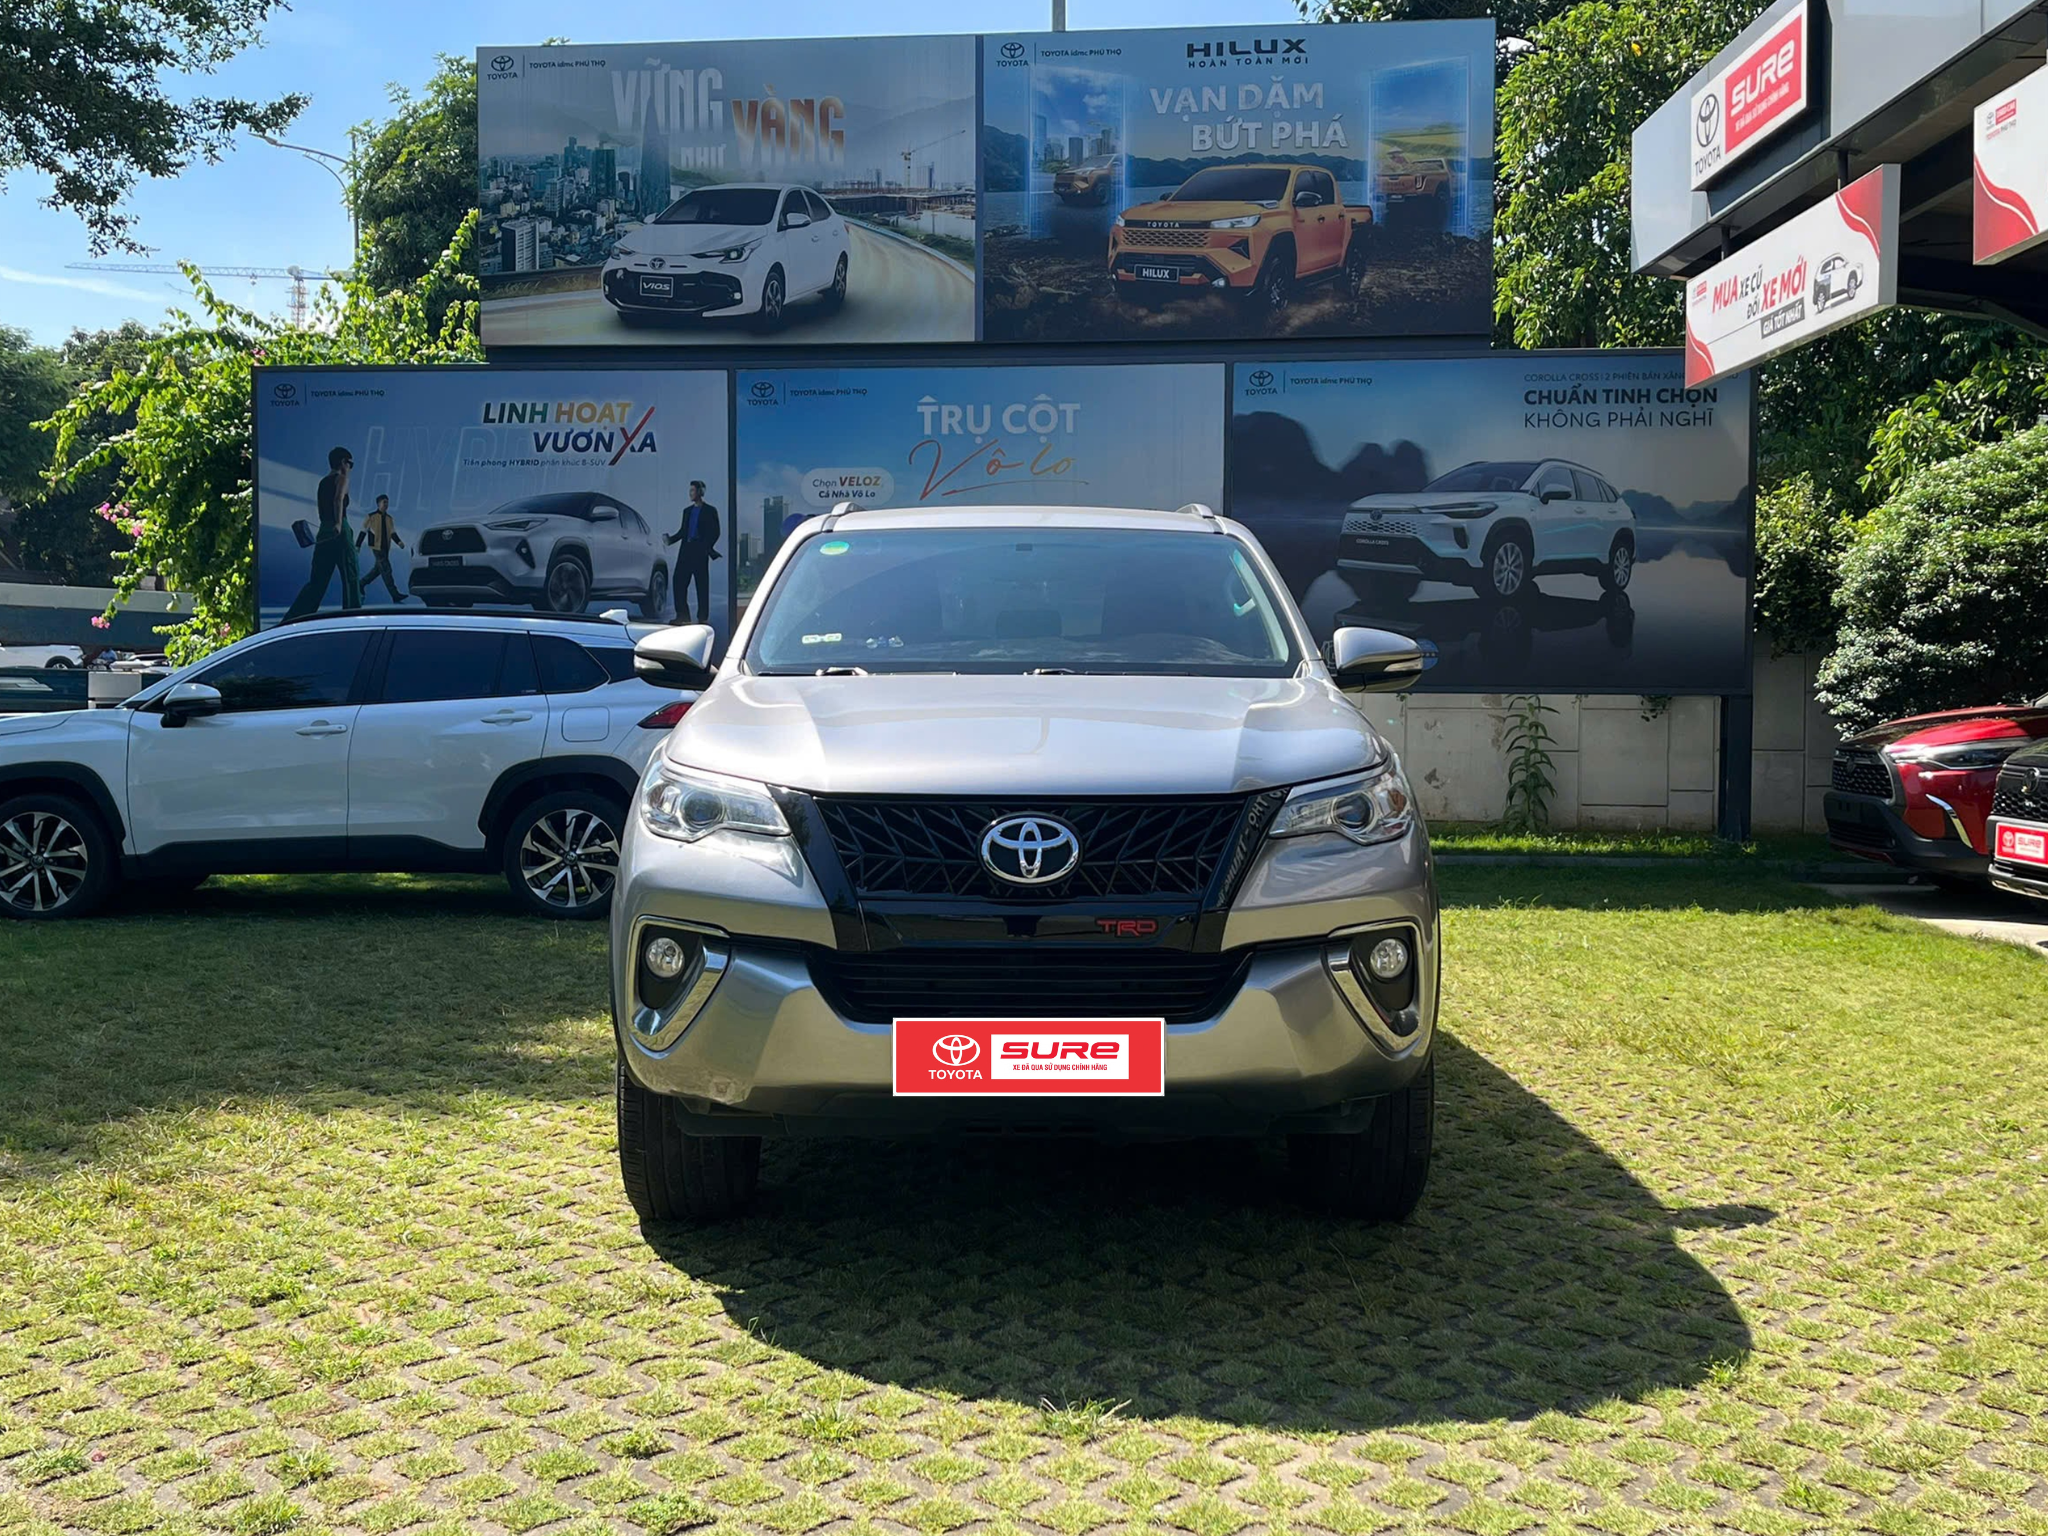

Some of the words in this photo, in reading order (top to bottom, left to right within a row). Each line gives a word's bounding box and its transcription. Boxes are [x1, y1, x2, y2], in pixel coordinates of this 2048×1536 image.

[1187, 39, 1307, 58] HILUX
[1188, 58, 1227, 68] HOÀN
[1236, 55, 1273, 66] TOÀN
[1282, 54, 1309, 64] MỚI
[487, 72, 518, 80] TOYOTA
[1150, 85, 1226, 122] VẠN
[1238, 75, 1323, 118] DẶM
[732, 83, 846, 165] VÀNG
[1192, 115, 1262, 151] BỨT
[1272, 113, 1348, 149] PHÁ
[1695, 145, 1721, 176] TOYOTA
[1142, 267, 1169, 279] HILUX
[643, 282, 670, 290] VIOS
[1761, 276, 1778, 313] XE
[1779, 254, 1807, 303] MỚI
[1712, 274, 1738, 314] MUA
[1739, 276, 1750, 299] XE
[1524, 373, 1568, 382] COROLLA
[1569, 373, 1599, 381] CROSS
[1605, 373, 1611, 381] 2
[1613, 371, 1639, 380] PHIÊN
[1245, 388, 1277, 396] TOYOTA
[1524, 383, 1597, 405] CHUẨN
[1602, 388, 1650, 404] TINH
[1656, 387, 1718, 408] CHỌN
[483, 402, 549, 424] LINH
[555, 402, 633, 430] HOẠT
[917, 396, 991, 444] TRỤ
[1002, 393, 1081, 443] CỘT
[1524, 408, 1600, 428] KHÔNG
[1608, 406, 1653, 427] PHẢI
[1660, 407, 1713, 427] NGHĨ
[533, 428, 615, 453] VƯƠN
[481, 458, 507, 467] phong
[509, 458, 540, 466] HYBRID
[812, 479, 837, 488] Chọn
[832, 490, 850, 498] Nhà
[865, 490, 876, 498] Lo
[1096, 919, 1157, 937] TRD
